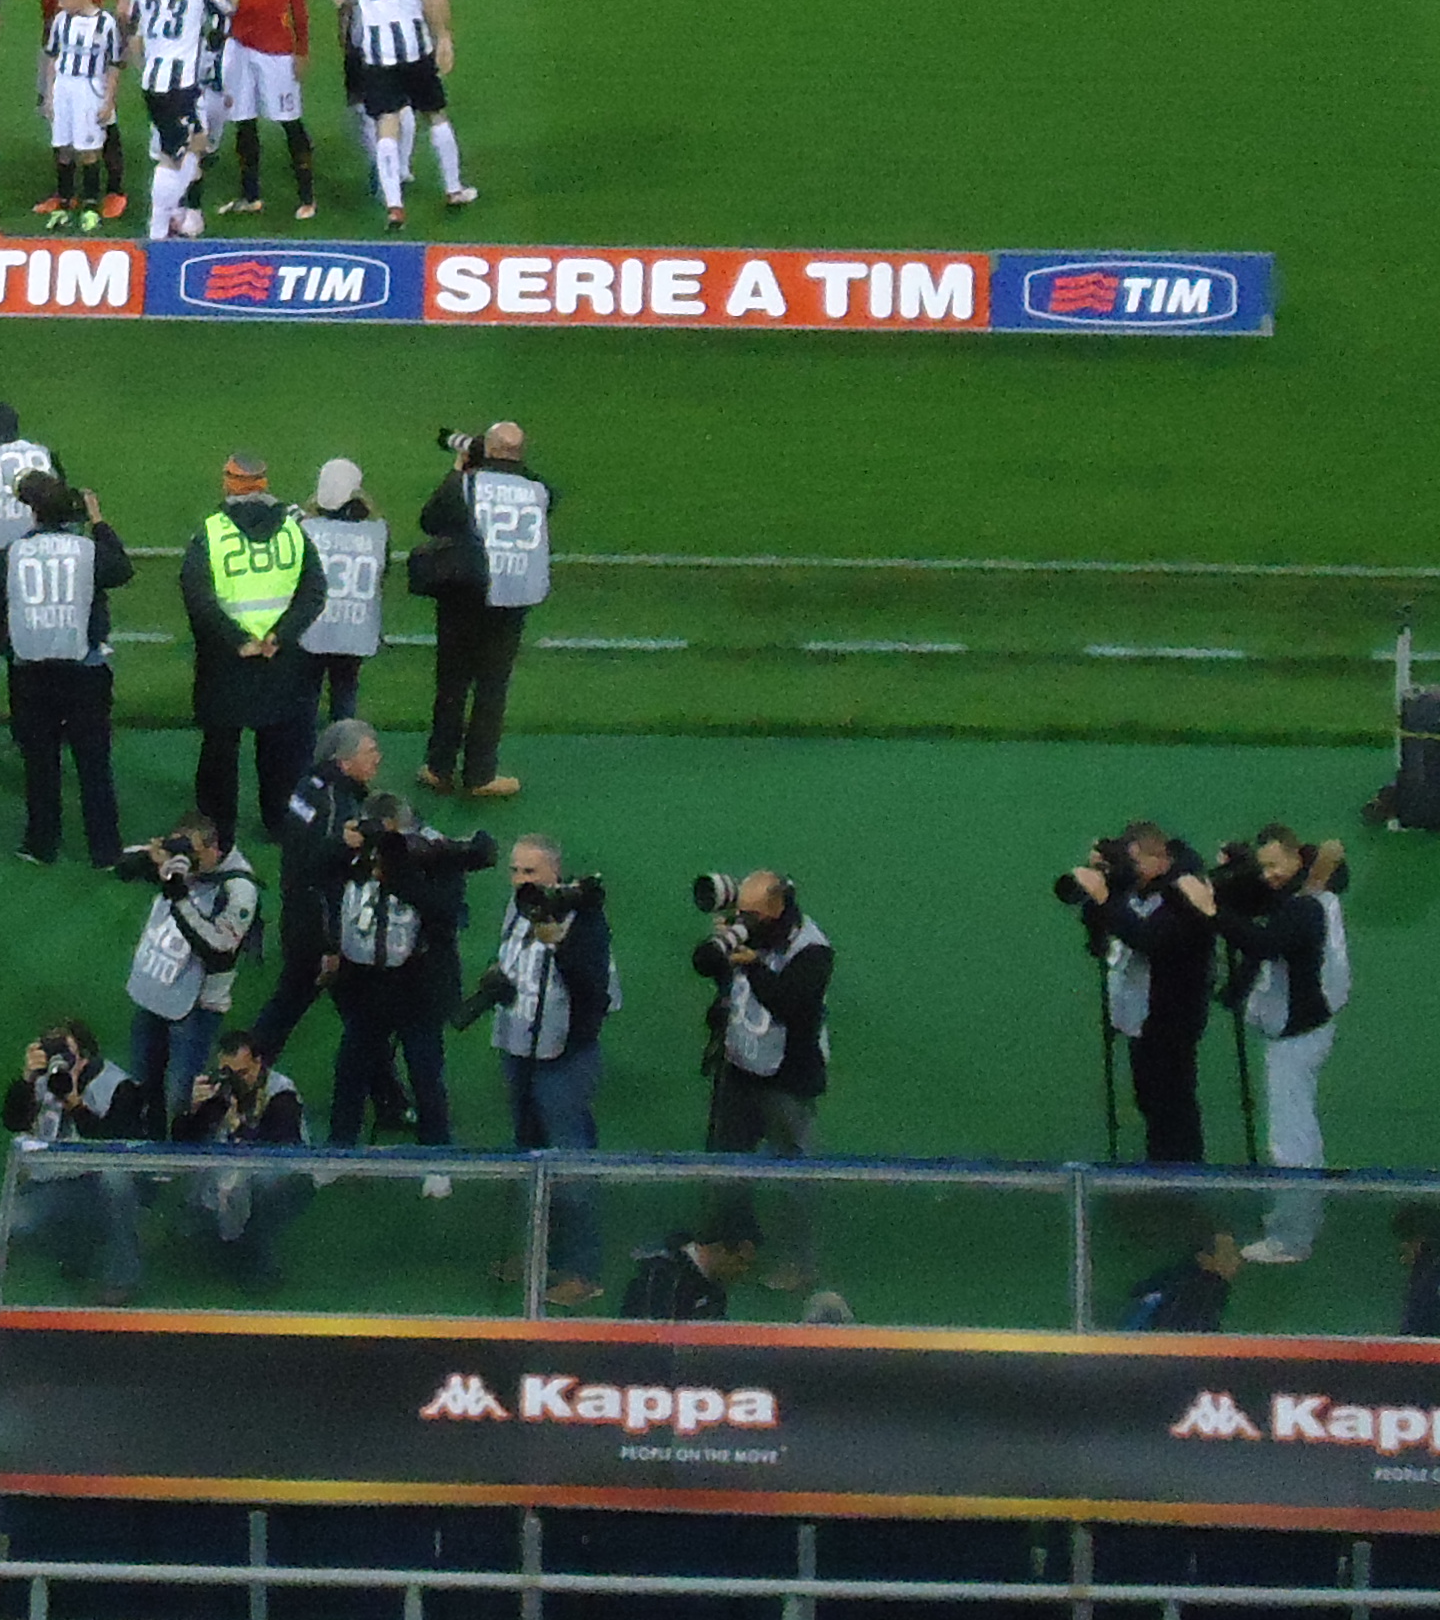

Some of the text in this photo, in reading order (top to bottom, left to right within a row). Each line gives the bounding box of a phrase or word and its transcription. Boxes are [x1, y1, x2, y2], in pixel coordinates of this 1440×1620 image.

[277, 266, 366, 303] TIM
[435, 255, 975, 320] SERIE A TIM
[1122, 276, 1213, 314] TIM
[220, 529, 296, 578] 280
[489, 551, 529, 577] OTO
[18, 557, 76, 605] 011
[521, 1374, 779, 1435] Kappa
[1271, 1394, 1440, 1458] Kap
